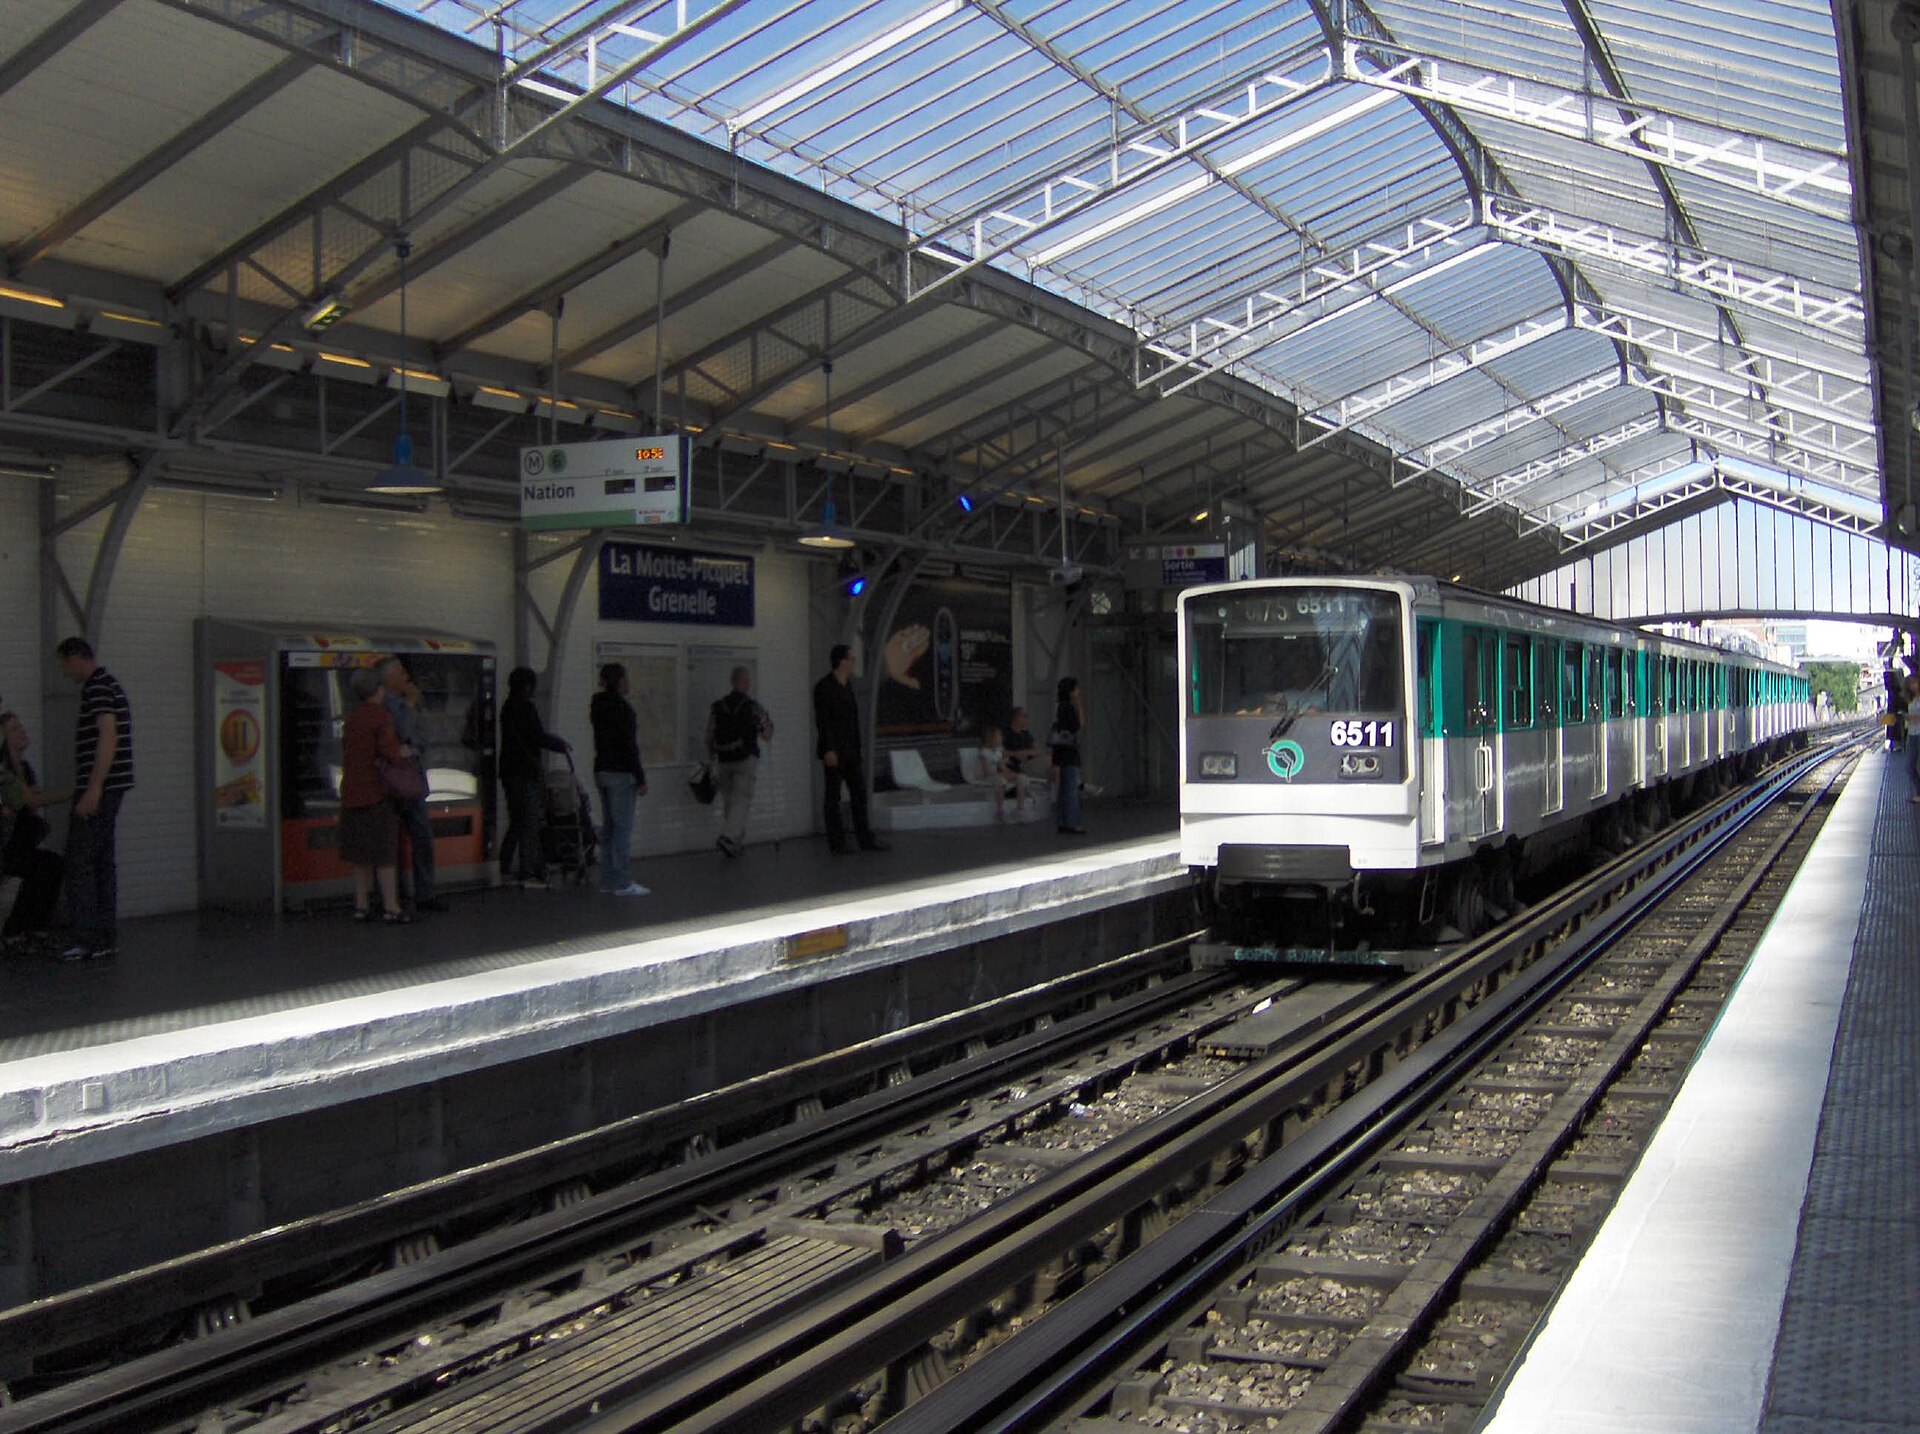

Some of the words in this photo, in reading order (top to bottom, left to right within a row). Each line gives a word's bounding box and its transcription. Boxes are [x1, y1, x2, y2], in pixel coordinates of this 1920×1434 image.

[524, 483, 575, 500] Nation
[609, 547, 632, 575] La
[635, 550, 748, 588] Motte-Picquet
[648, 585, 717, 615] Grenelle
[1331, 720, 1393, 747] 6511
